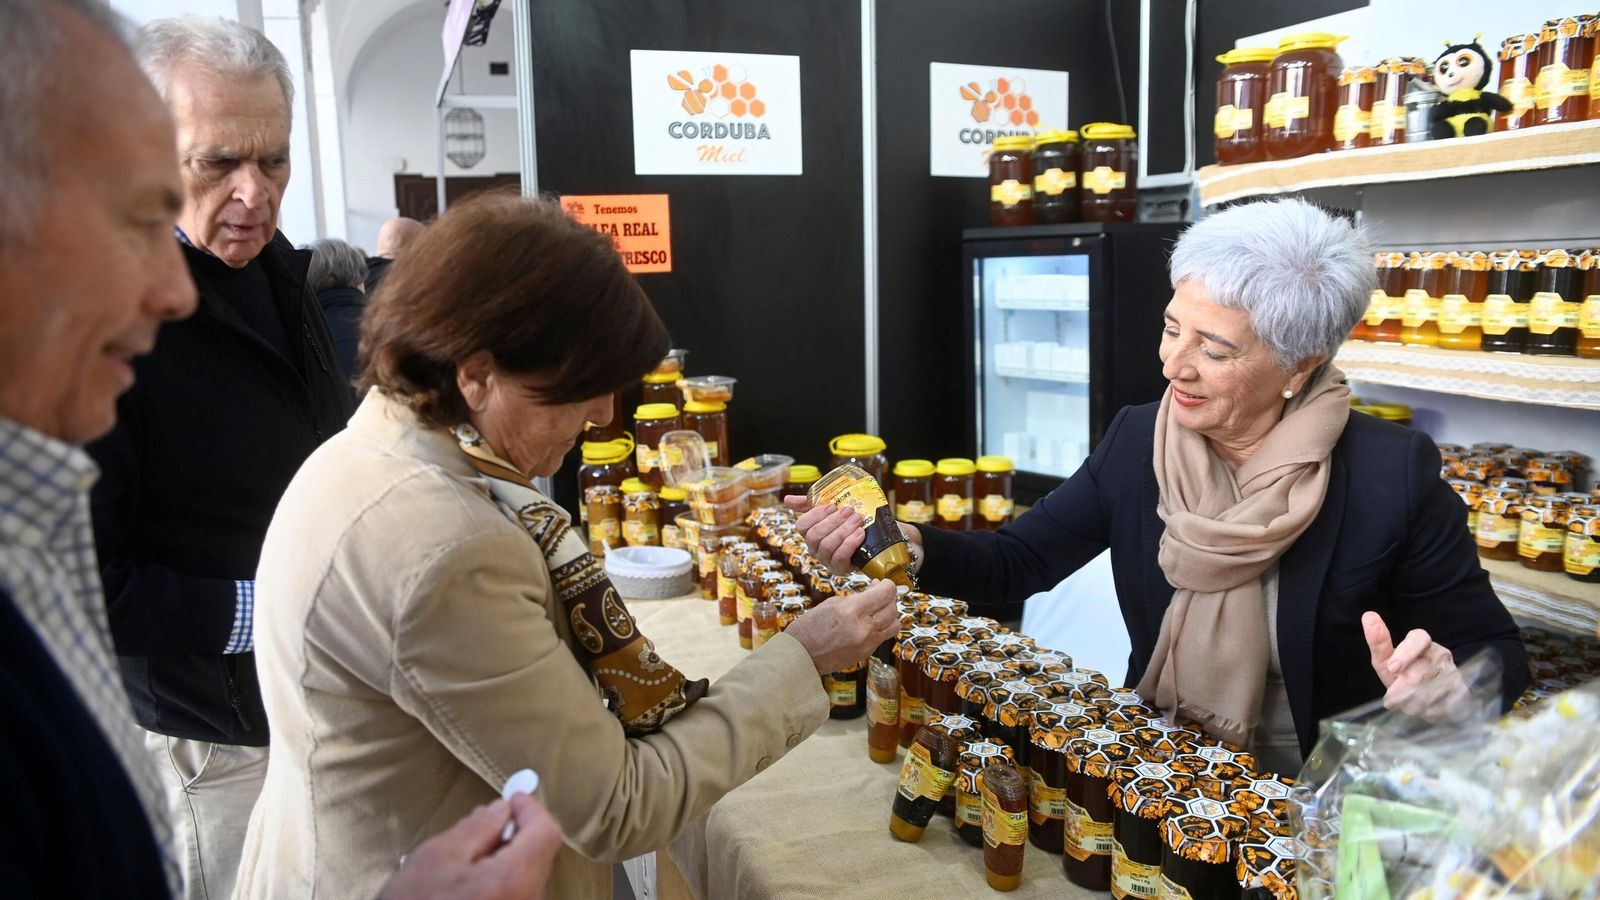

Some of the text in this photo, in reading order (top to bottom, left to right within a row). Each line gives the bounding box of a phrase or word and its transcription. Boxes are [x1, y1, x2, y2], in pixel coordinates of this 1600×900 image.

[668, 121, 771, 140] CORDUBA
[696, 145, 746, 163] Miel
[593, 204, 638, 215] Tenemos
[623, 222, 658, 237] REAL
[622, 250, 667, 265] RESCO
